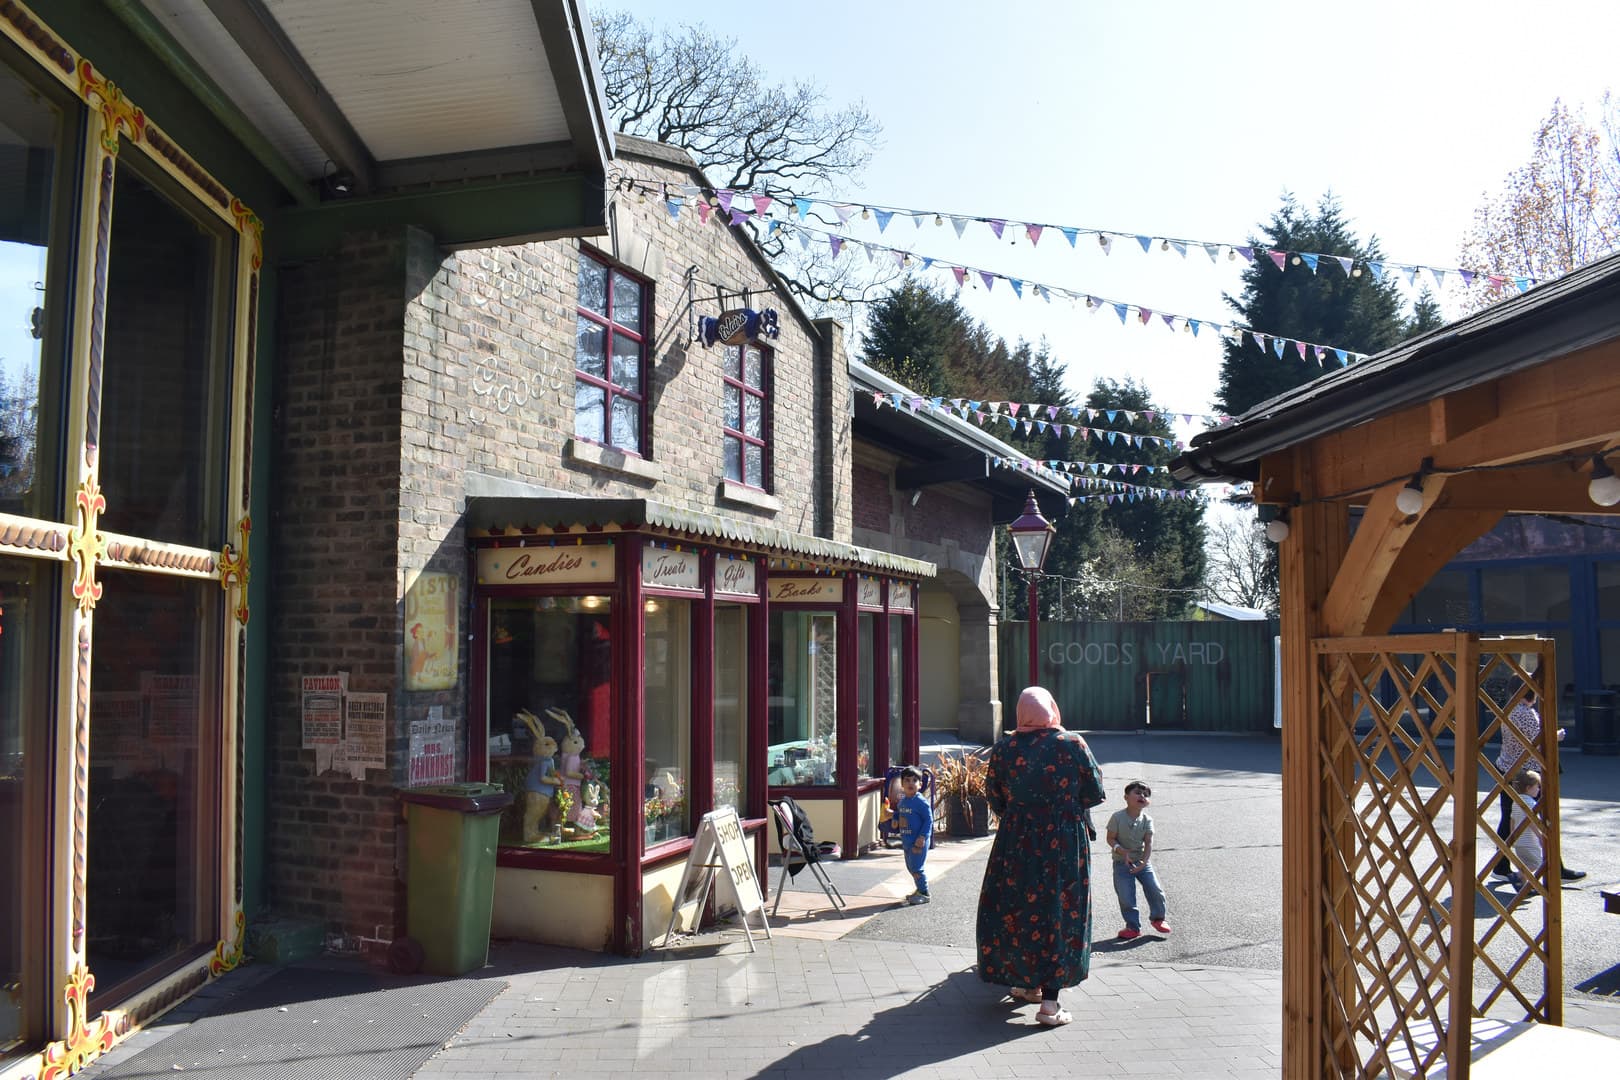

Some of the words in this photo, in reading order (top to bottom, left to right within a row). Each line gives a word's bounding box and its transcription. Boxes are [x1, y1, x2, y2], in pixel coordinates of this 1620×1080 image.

[719, 312, 747, 341] Eclairs
[505, 552, 583, 579] Candies
[653, 555, 687, 579] Treats
[724, 563, 746, 588] Gifts
[776, 581, 822, 599] Books
[1048, 642, 1133, 665] GOODS
[1156, 642, 1225, 665] YARD
[303, 677, 340, 690] PAVILION
[411, 752, 454, 780] PANKHURST
[717, 821, 740, 845] SHOP
